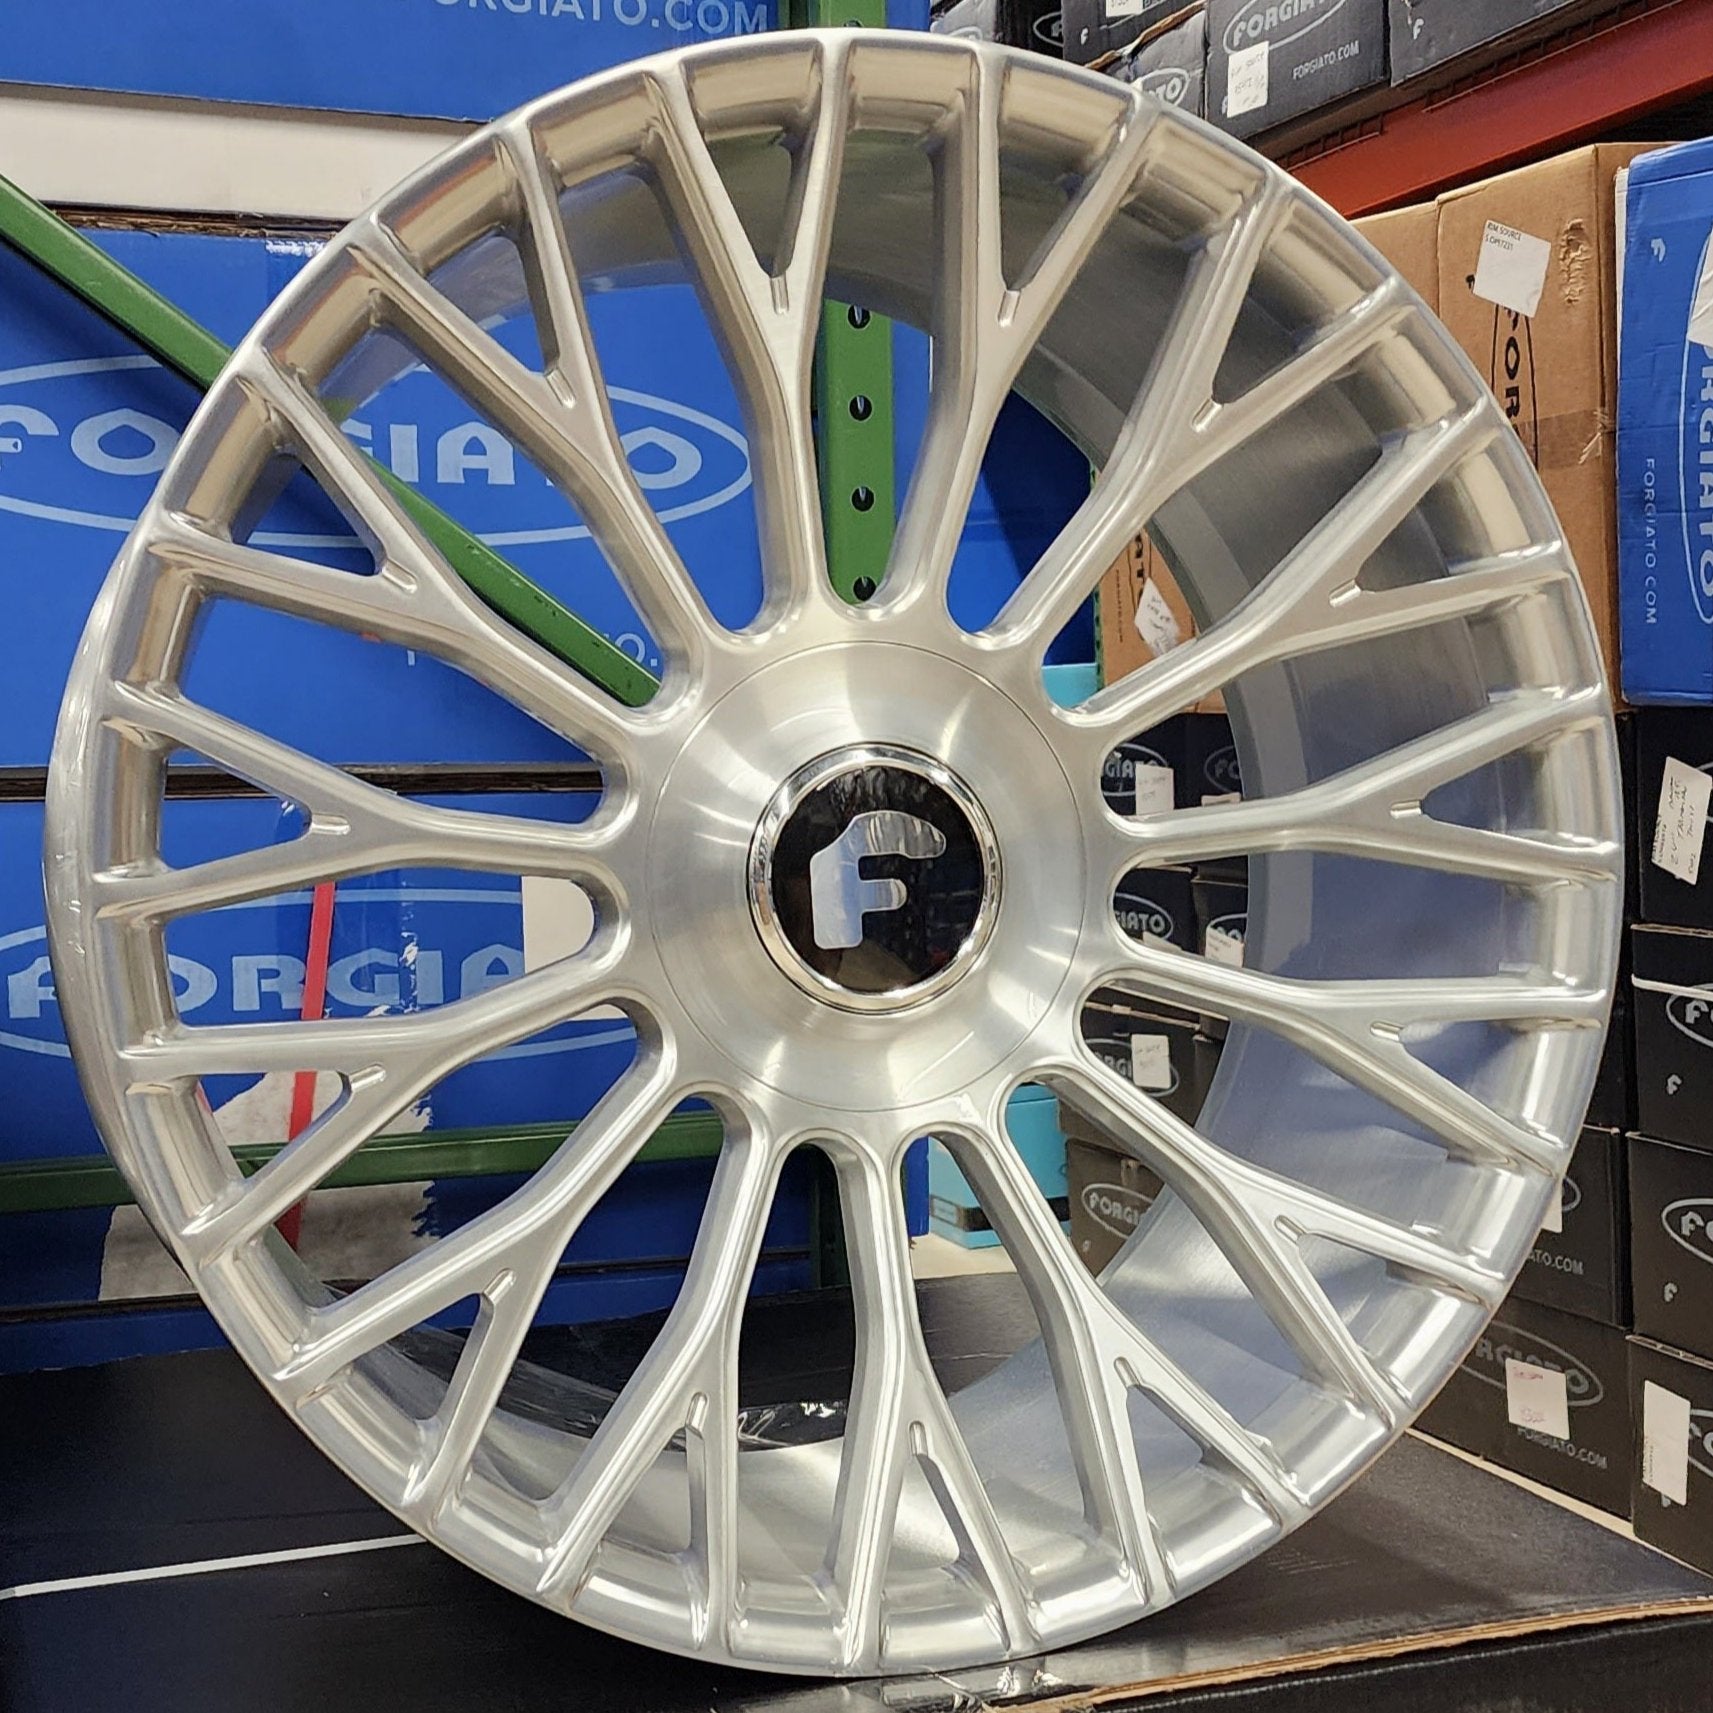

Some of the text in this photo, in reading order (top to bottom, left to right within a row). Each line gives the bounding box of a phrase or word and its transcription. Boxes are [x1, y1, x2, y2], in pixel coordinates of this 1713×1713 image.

[1232, 0, 1326, 47] FORGIA
[1412, 18, 1425, 40] F
[1292, 40, 1360, 81] FORGIATO.COM
[809, 809, 947, 950] F
[1666, 1073, 1682, 1096] F
[1663, 1282, 1678, 1303] F
